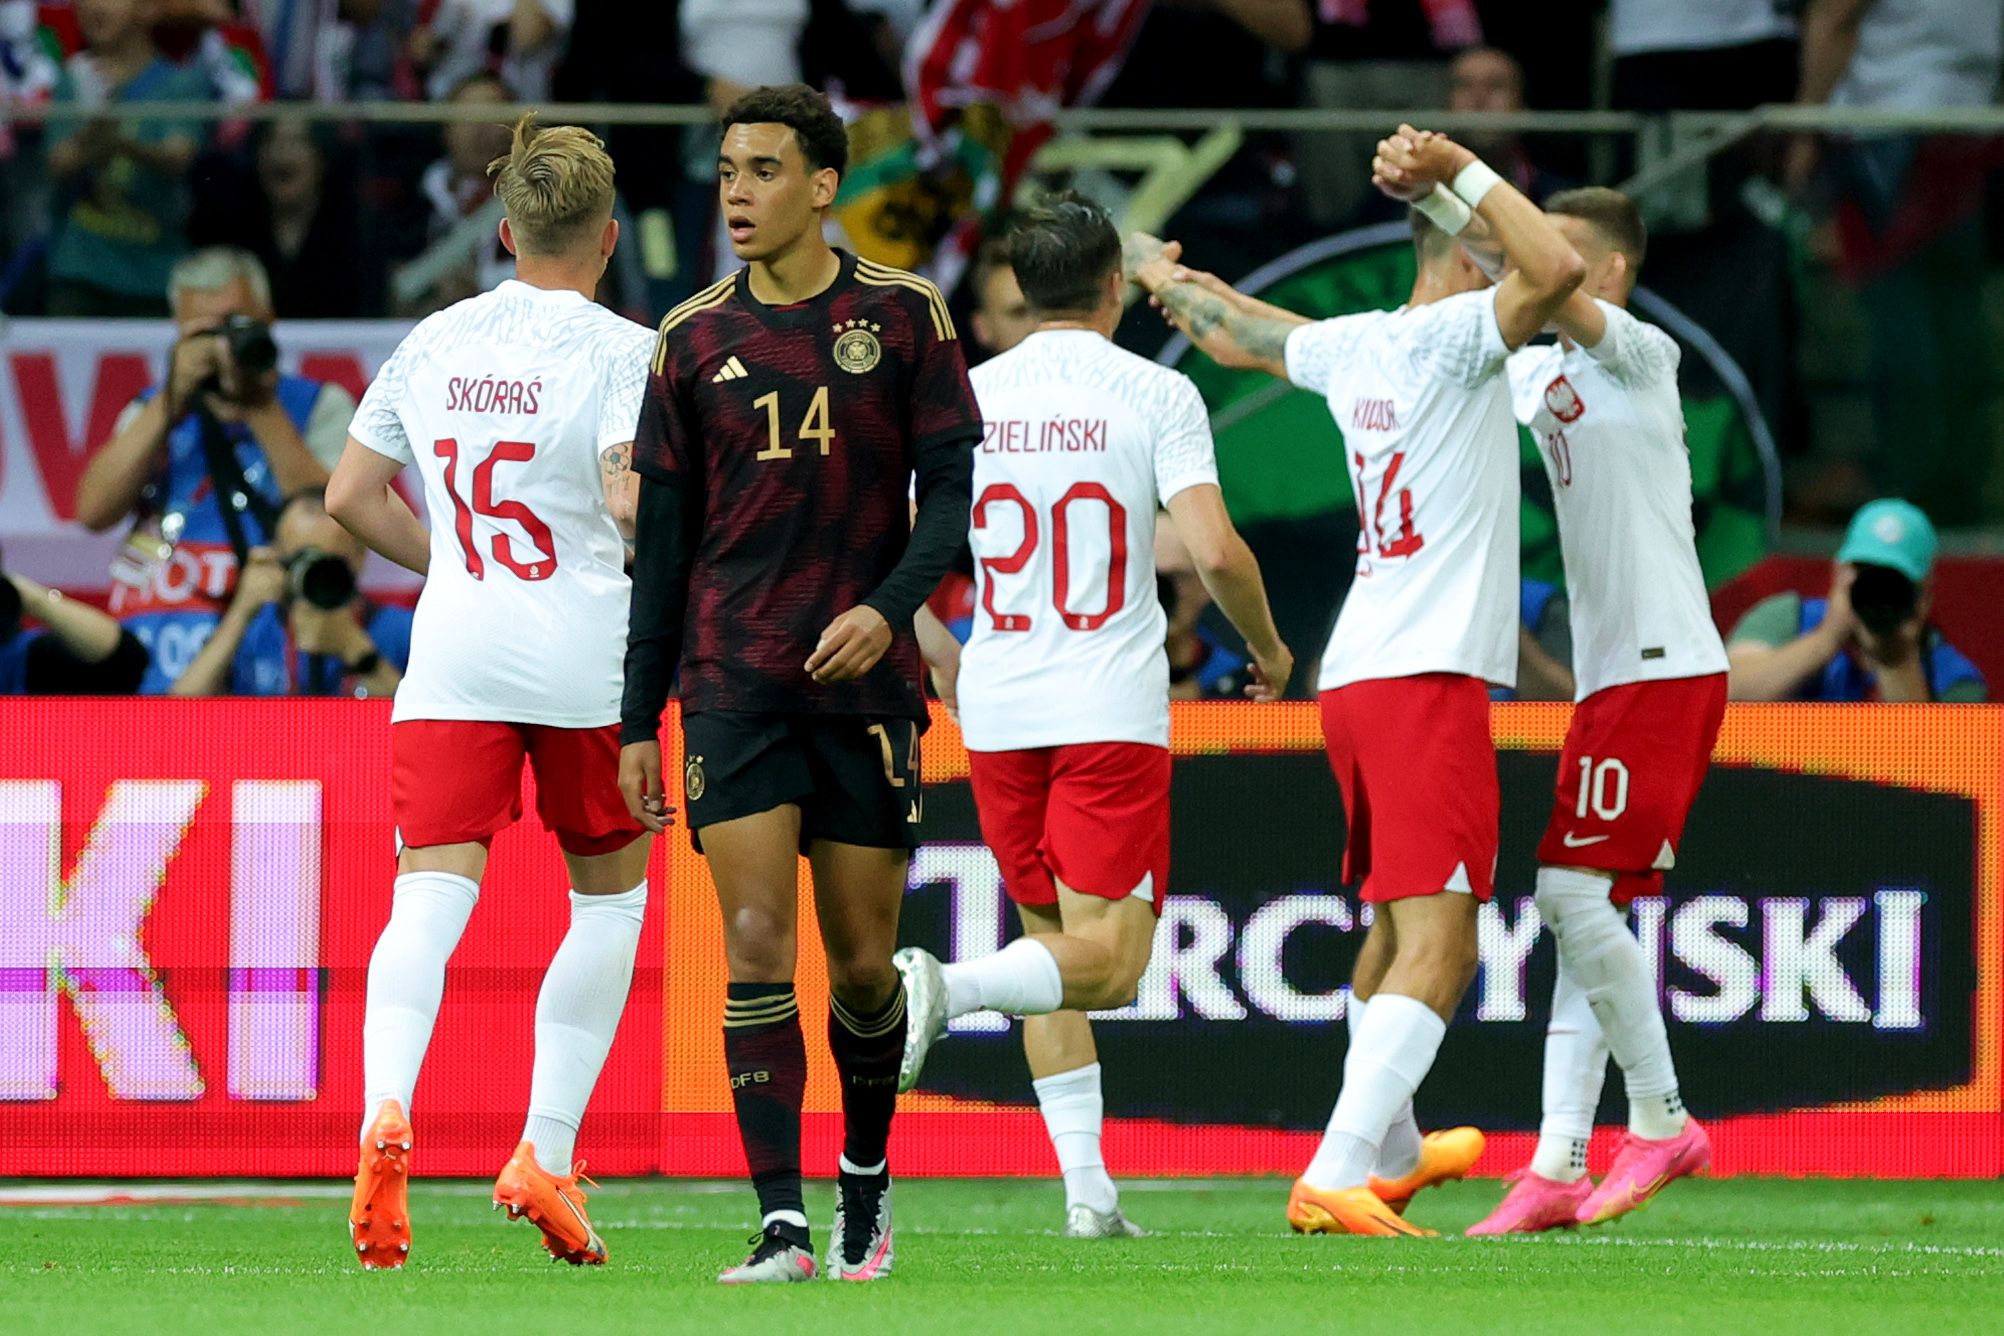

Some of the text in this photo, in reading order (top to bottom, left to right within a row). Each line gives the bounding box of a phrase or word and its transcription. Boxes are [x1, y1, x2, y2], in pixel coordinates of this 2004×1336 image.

[446, 373, 542, 415] SKÓRAŚ
[753, 386, 836, 461] 14
[983, 413, 1107, 453] ZIELIŃSKI
[433, 437, 558, 581] 15
[972, 481, 1127, 632] 20
[1576, 755, 1630, 821] 10
[907, 842, 1924, 1032] TRCYSKI
